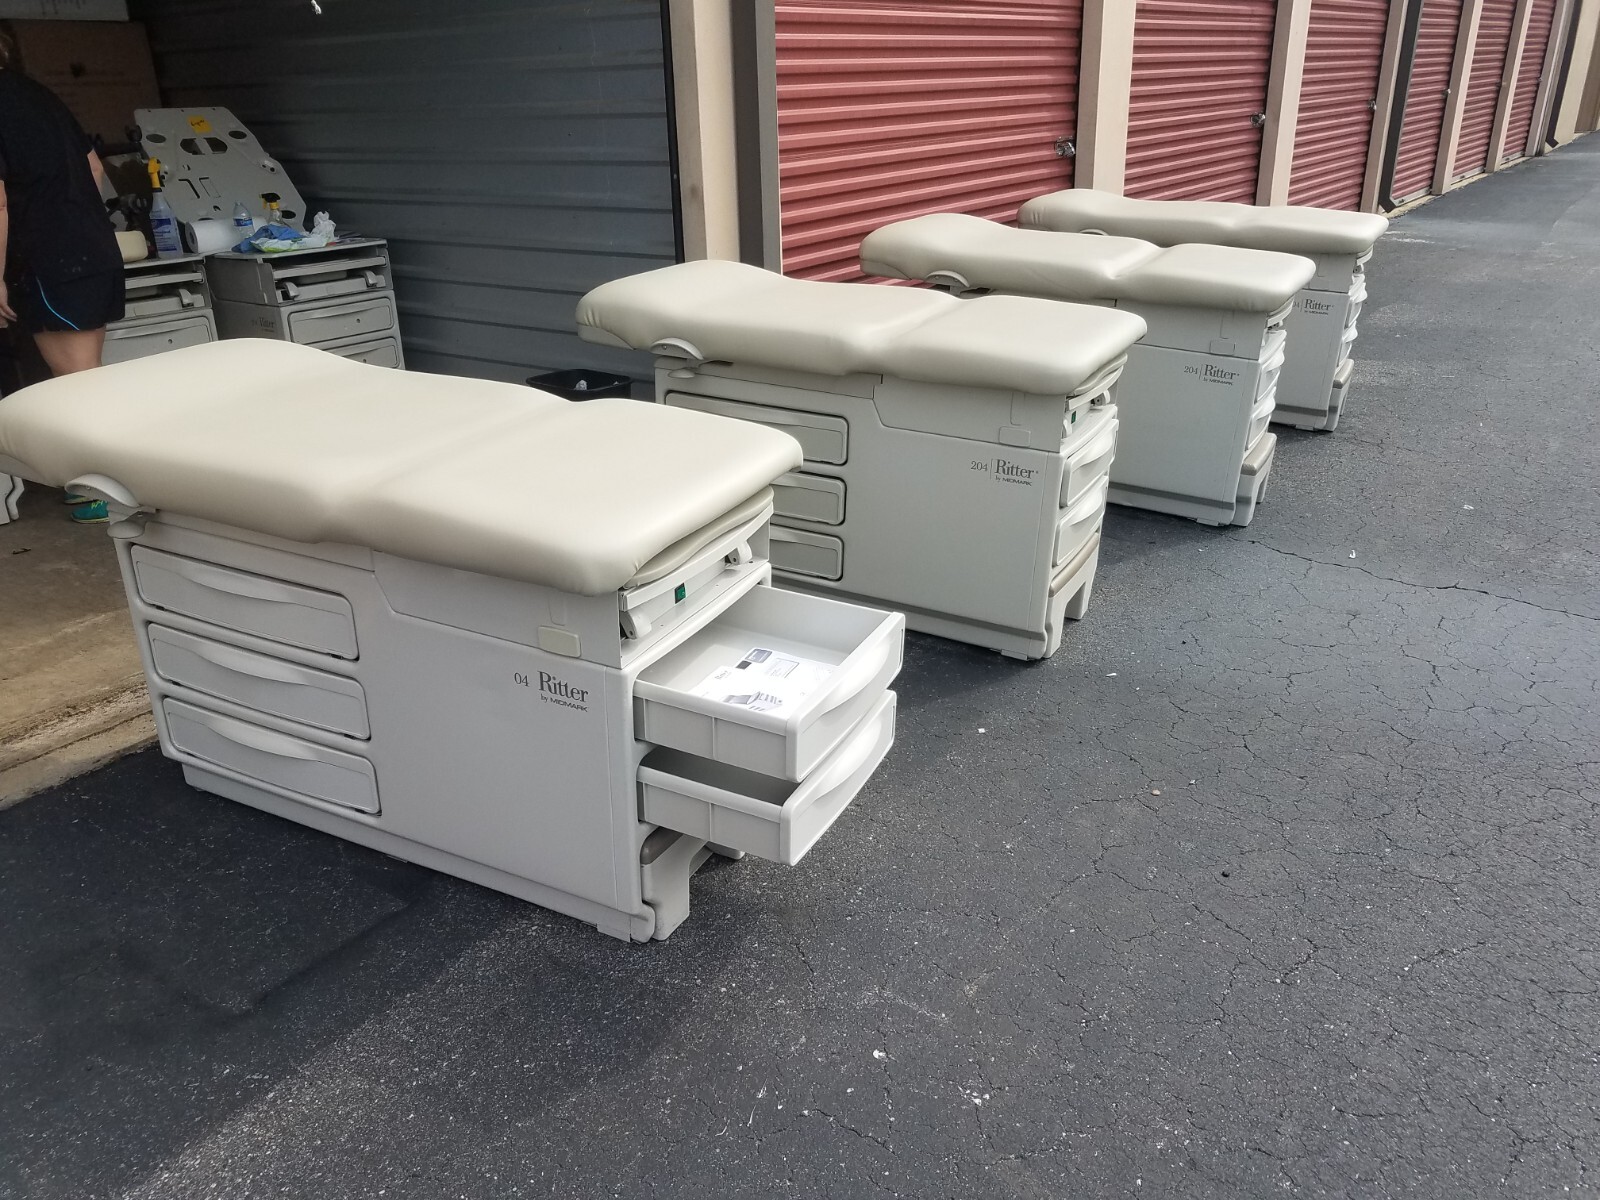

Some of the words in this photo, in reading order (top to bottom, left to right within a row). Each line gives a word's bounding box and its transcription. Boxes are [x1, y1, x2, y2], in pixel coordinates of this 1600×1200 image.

[1304, 299, 1331, 311] Ritter
[1183, 365, 1199, 375] 204
[1204, 364, 1237, 380] Ritter
[970, 460, 988, 472] 204
[994, 458, 1035, 480] Ritter
[1002, 476, 1033, 487] MIDMARK
[514, 672, 530, 688] 04
[537, 670, 590, 703] Ritter
[540, 693, 549, 704] by
[550, 696, 589, 713] MIDMARK
